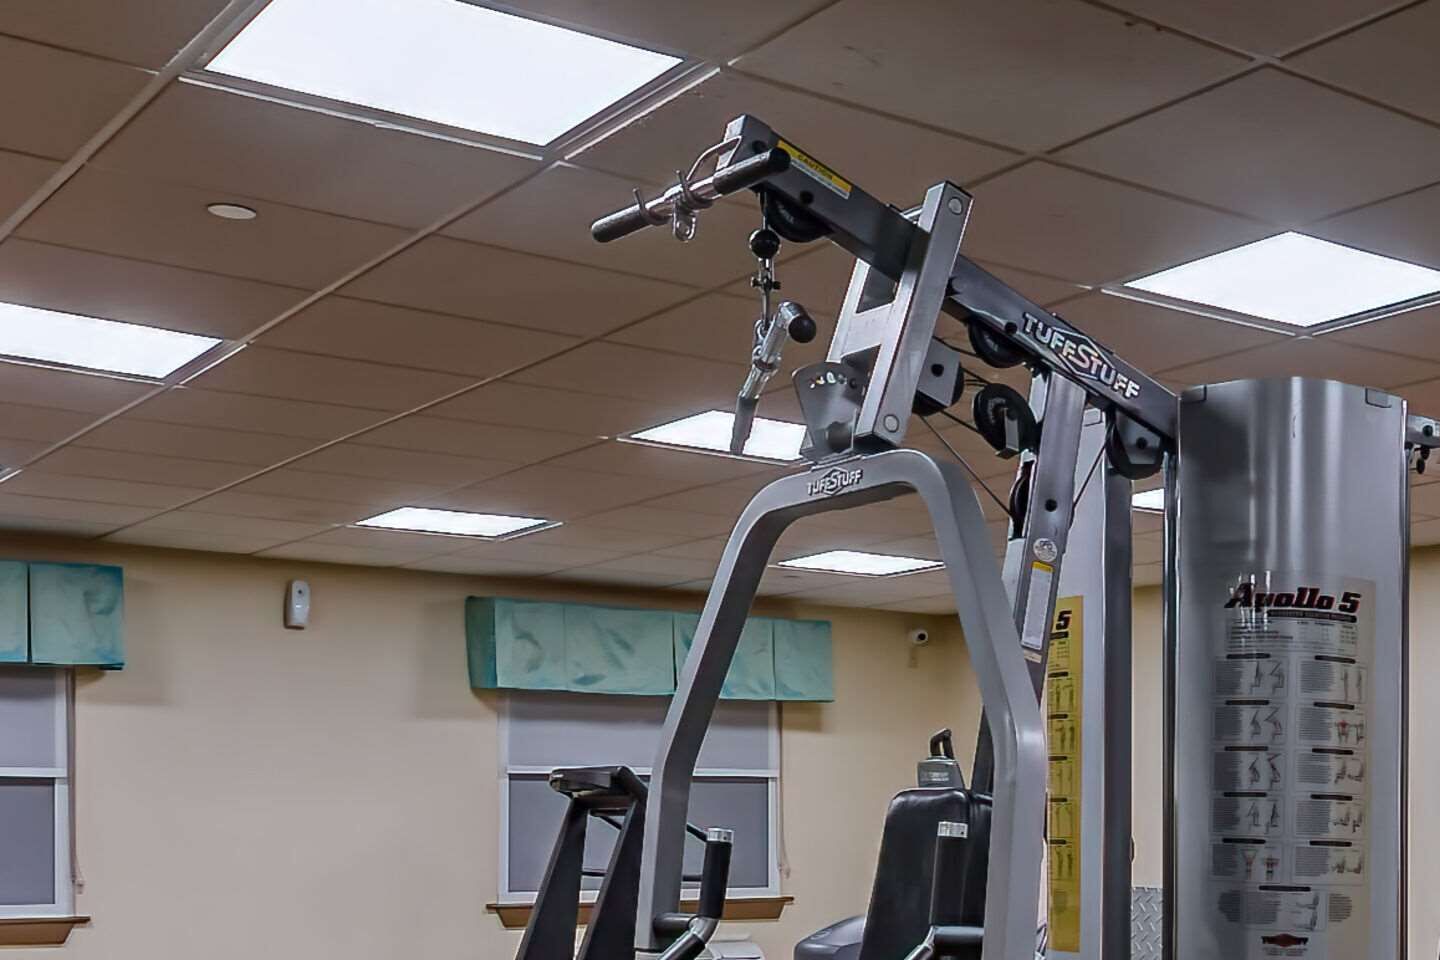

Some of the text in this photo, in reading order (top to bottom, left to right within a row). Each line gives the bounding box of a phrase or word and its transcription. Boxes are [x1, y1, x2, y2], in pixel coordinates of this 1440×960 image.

[1023, 311, 1140, 399] TUFFSTUFF
[806, 468, 863, 496] TUFFSTUFF
[1224, 582, 1361, 613] Apollo 5
[1055, 609, 1072, 631] 5
